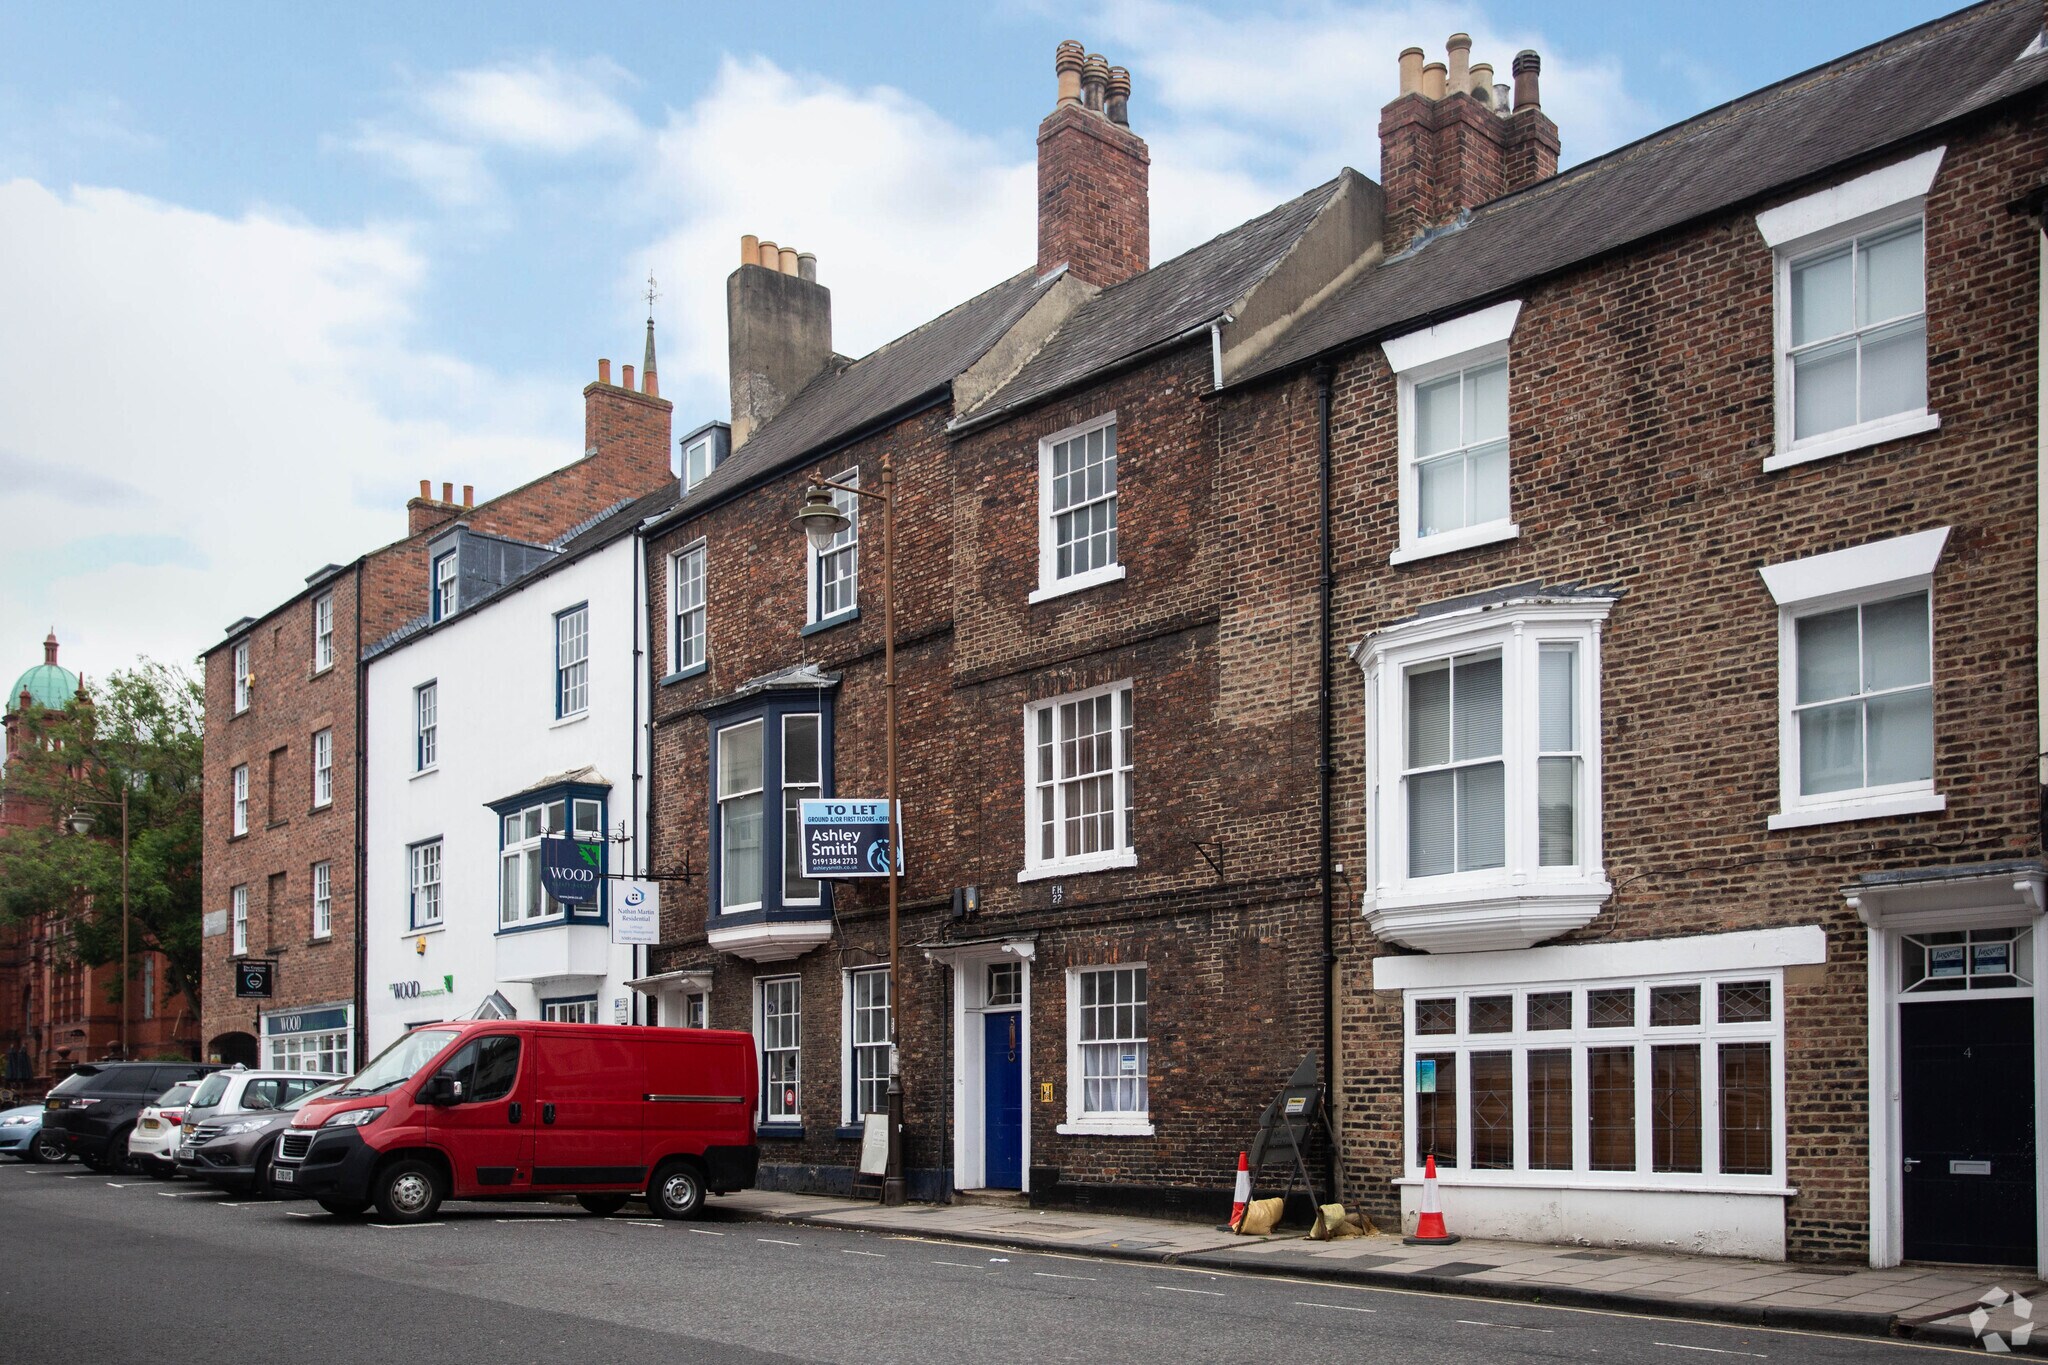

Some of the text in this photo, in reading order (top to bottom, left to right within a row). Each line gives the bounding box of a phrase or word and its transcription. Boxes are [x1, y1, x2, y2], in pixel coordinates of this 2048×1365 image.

[825, 805, 878, 815] TO LET
[811, 829, 861, 844] Ashley
[812, 842, 857, 856] Smith
[842, 857, 858, 865] 2733
[549, 866, 594, 882] WOOD
[1935, 948, 1961, 960] Jaggers
[1977, 945, 2004, 957] Jaggers
[392, 980, 420, 999] WOOD
[280, 1015, 302, 1032] WOOD
[1010, 1015, 1015, 1025] 5
[1963, 1046, 1972, 1059] 4
